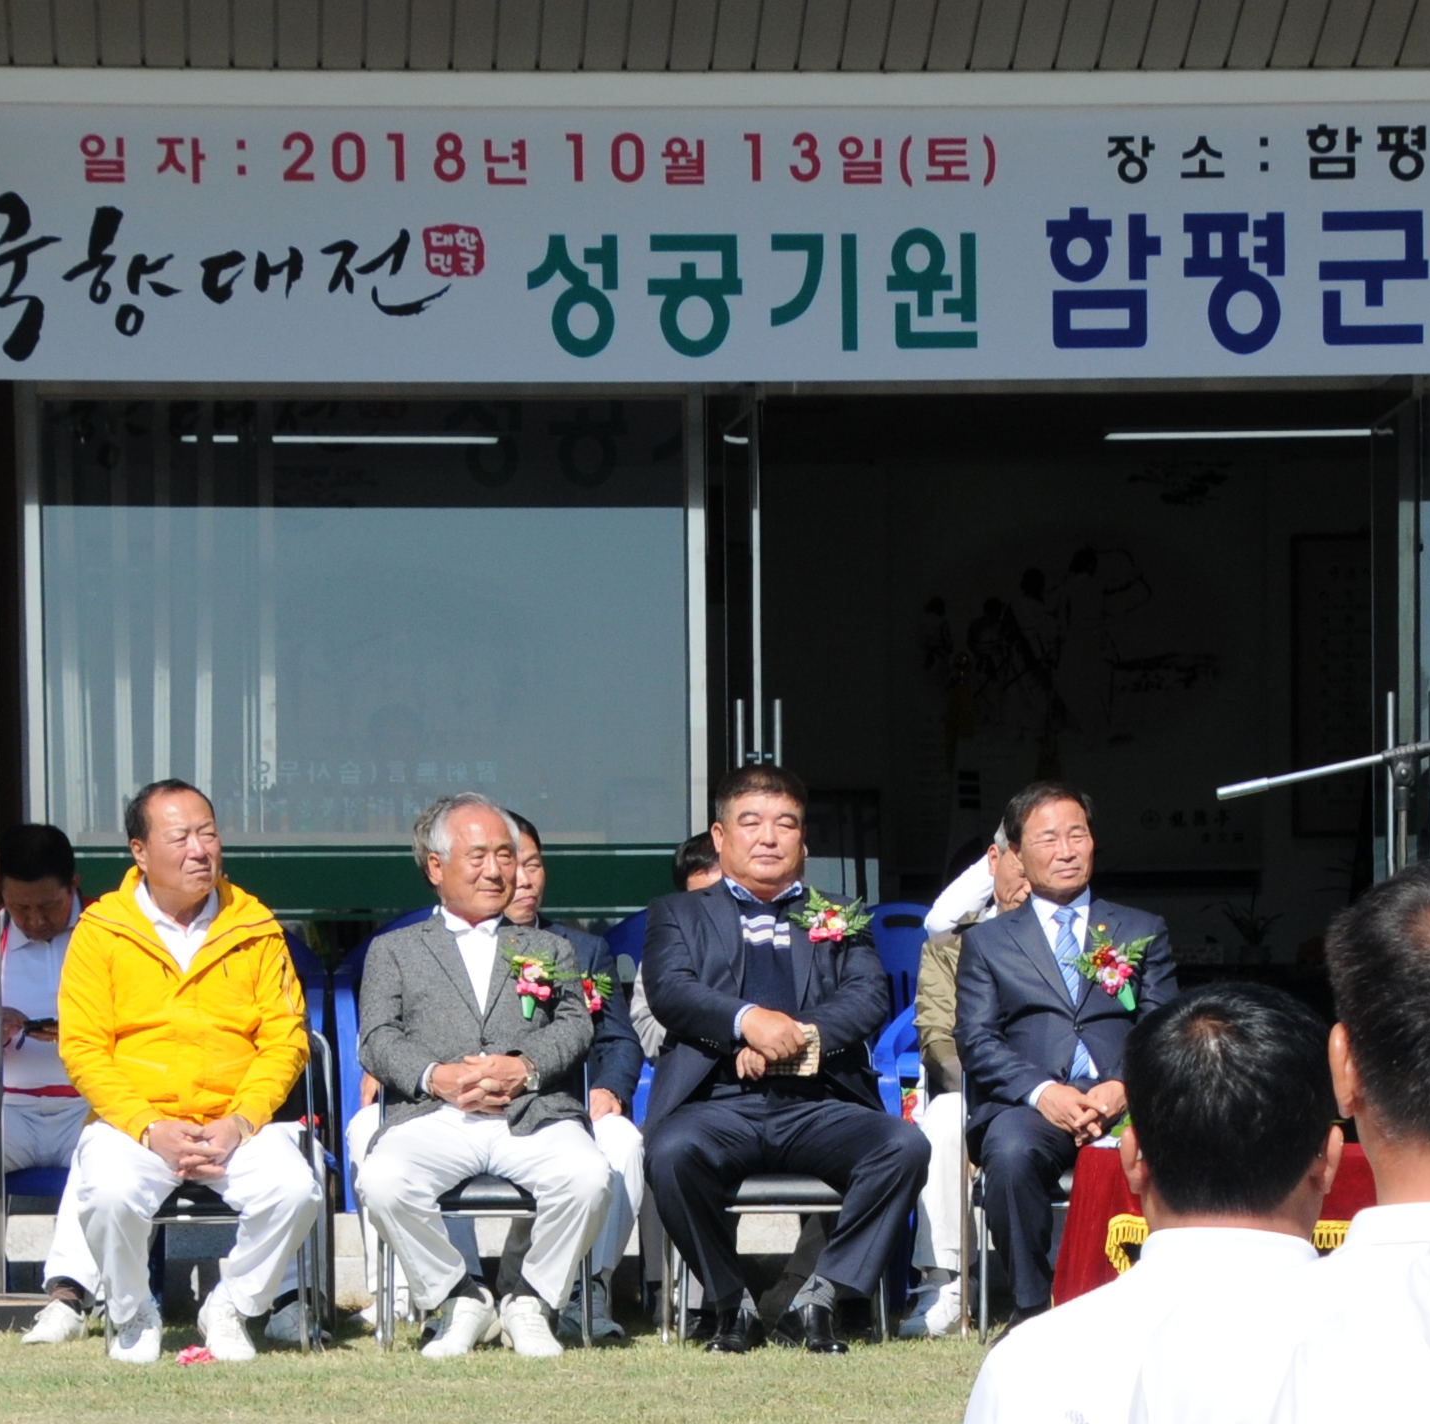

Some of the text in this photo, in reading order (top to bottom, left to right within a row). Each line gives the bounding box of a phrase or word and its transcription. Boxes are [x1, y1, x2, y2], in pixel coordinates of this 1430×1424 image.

[279, 131, 531, 185] 2018년
[564, 132, 708, 185] 10월
[742, 131, 999, 186] 13일(토)
[525, 226, 979, 359] 성공기원
